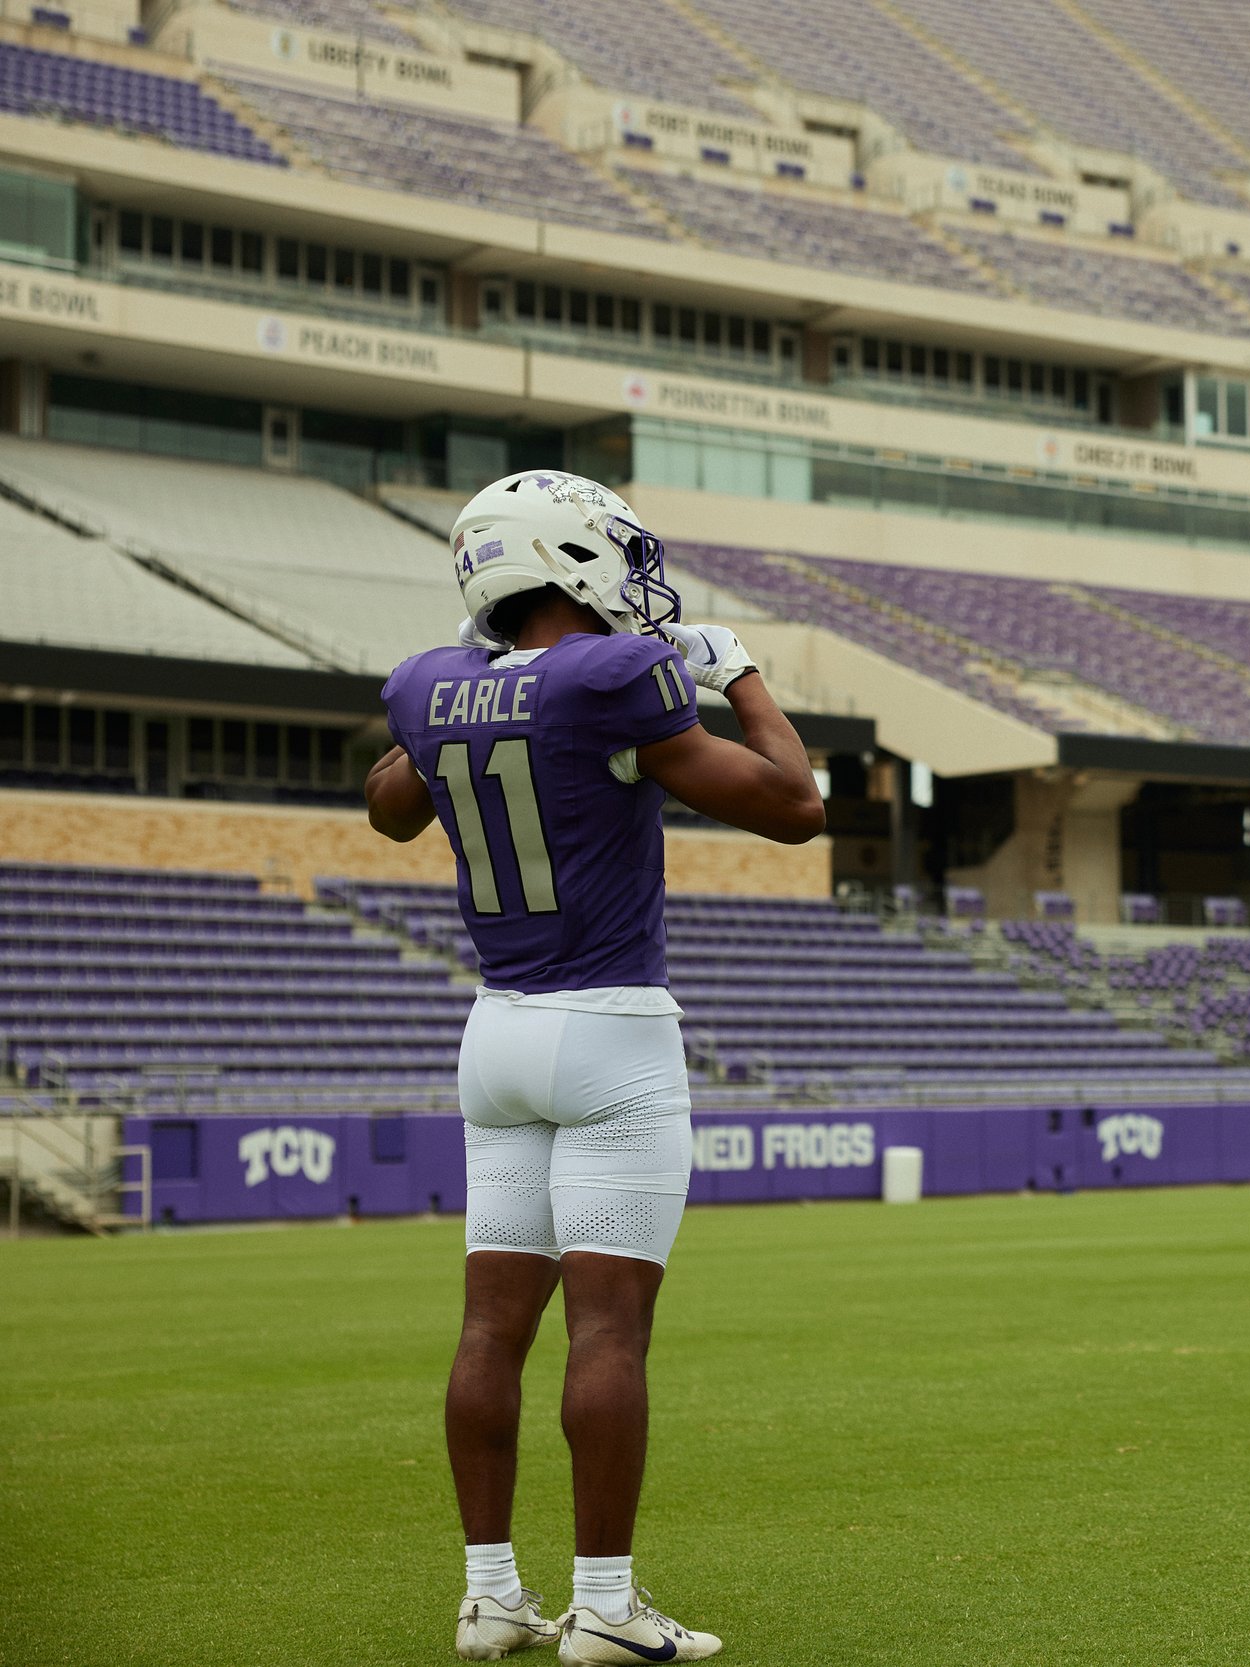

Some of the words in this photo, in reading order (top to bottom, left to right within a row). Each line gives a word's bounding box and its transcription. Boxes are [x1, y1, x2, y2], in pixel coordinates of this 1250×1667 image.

[307, 38, 391, 75] LIBERTY
[394, 56, 452, 90] BOWL
[645, 110, 690, 134] FORT
[695, 122, 757, 147] WORTH
[764, 134, 812, 158] BOWL
[977, 175, 1026, 199] TEXAS
[1033, 186, 1077, 210] BOWL
[29, 282, 101, 322] BOWL
[301, 327, 371, 360] PEACH
[376, 339, 438, 373] BOWL
[658, 383, 770, 418] POINSETTIA
[775, 401, 830, 428] BOWL
[1152, 454, 1198, 479] BOWL
[428, 674, 538, 727] EARLE
[650, 658, 690, 713] 11
[434, 736, 562, 917] 11
[238, 1125, 336, 1188] TCU
[762, 1122, 876, 1170] FROGS
[1097, 1112, 1164, 1163] TCU
